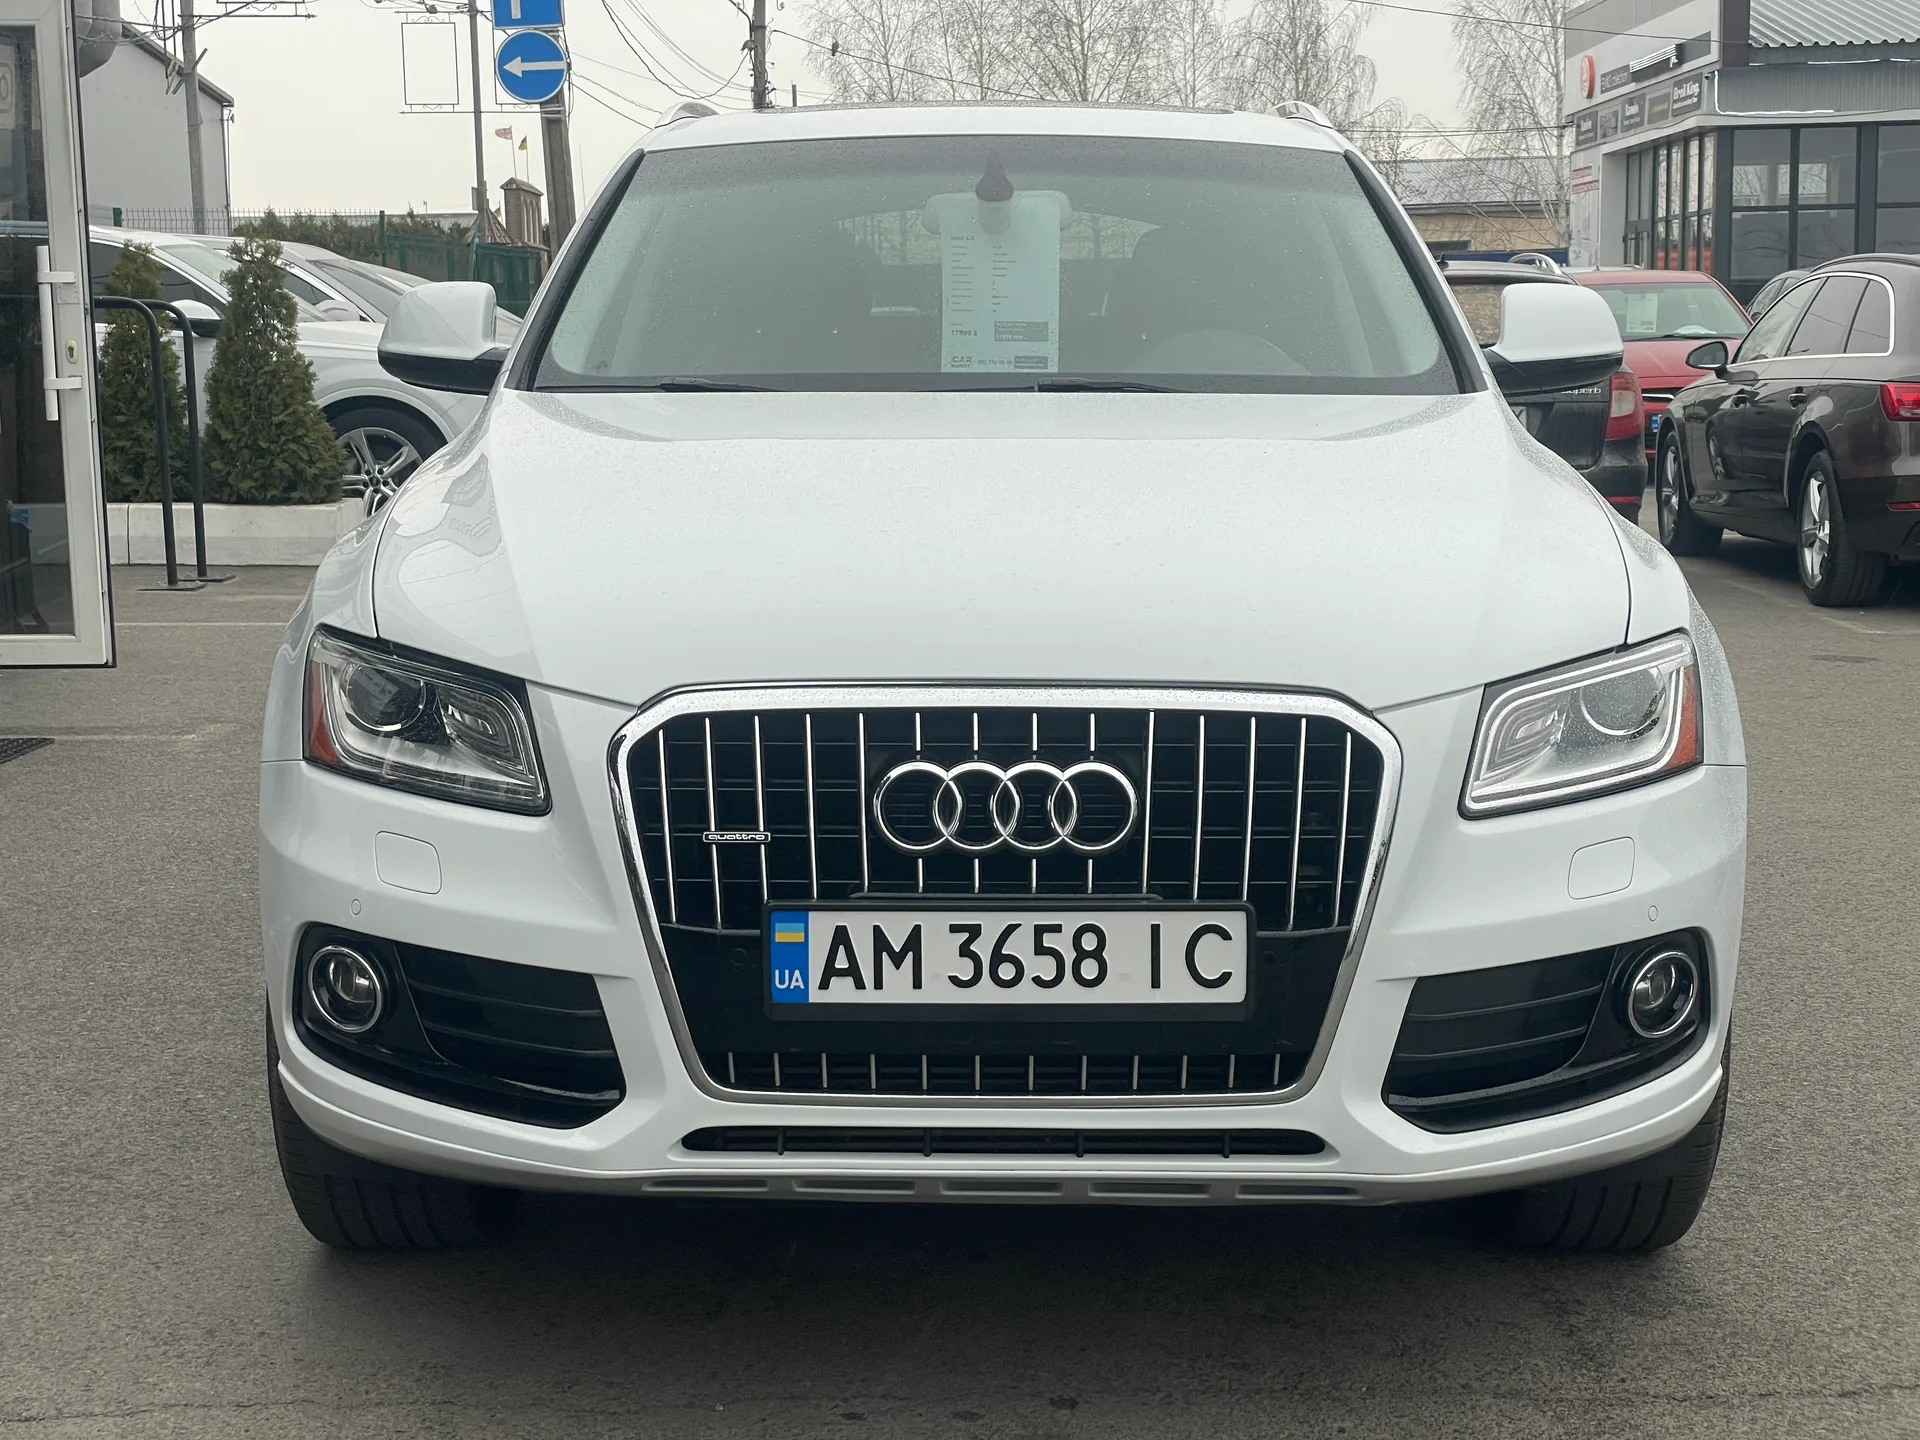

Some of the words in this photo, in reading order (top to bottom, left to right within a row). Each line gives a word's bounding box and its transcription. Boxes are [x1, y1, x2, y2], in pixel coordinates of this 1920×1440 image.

[708, 833, 766, 841] quattro
[818, 924, 923, 990] AM
[947, 922, 1109, 990] 3658
[1150, 923, 1233, 988] IC
[774, 968, 805, 990] UA
